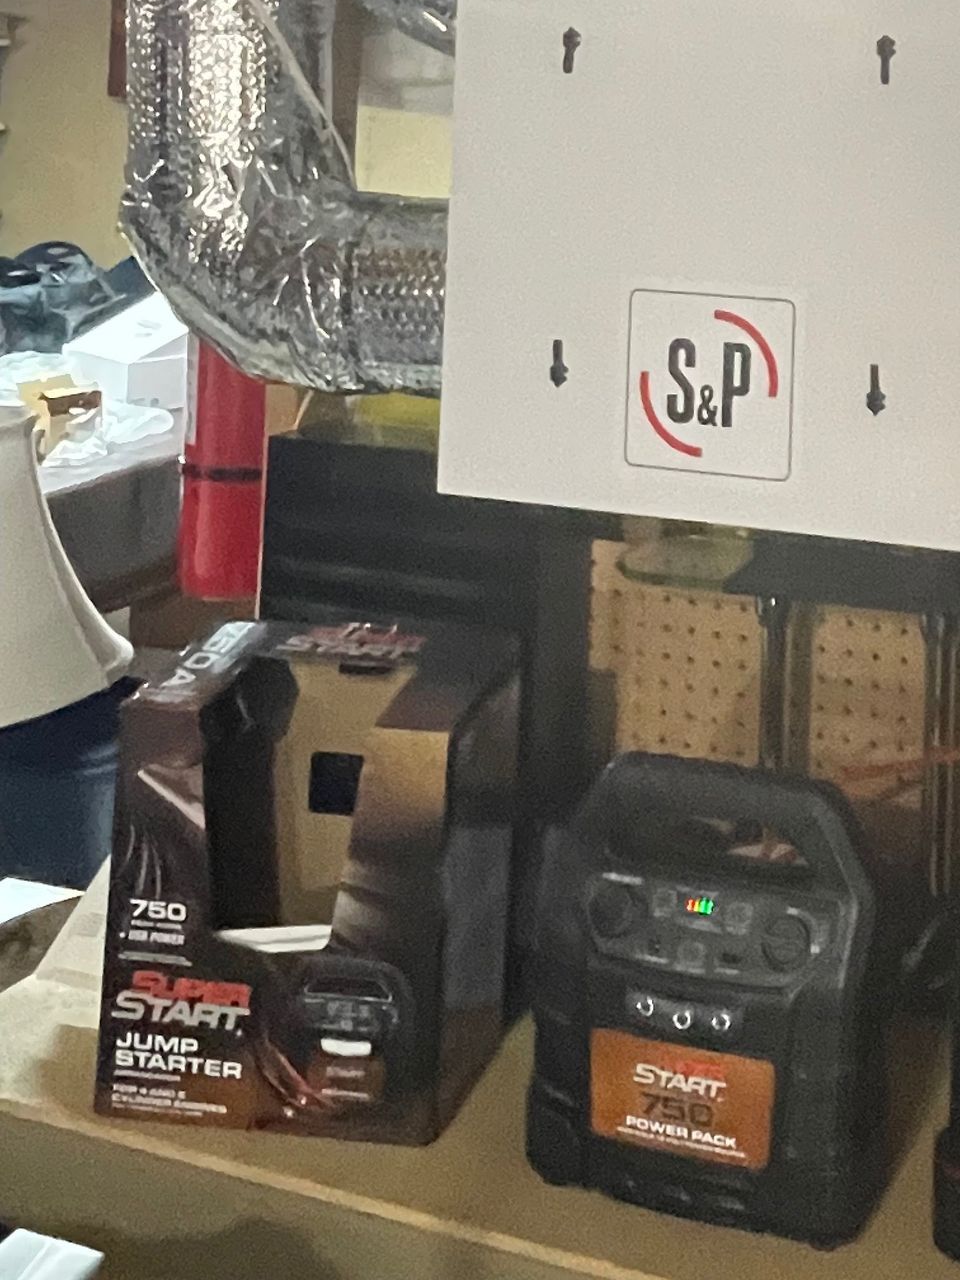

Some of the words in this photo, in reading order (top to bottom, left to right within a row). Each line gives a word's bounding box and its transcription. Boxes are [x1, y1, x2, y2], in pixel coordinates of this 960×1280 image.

[666, 337, 752, 427] S&P
[129, 898, 187, 921] 750
[111, 989, 250, 1030] START
[115, 1032, 199, 1054] JUMP
[115, 1049, 242, 1079] STARTER
[633, 1063, 727, 1098] START
[641, 1090, 715, 1126] 750
[626, 1115, 689, 1140] POWER
[691, 1130, 737, 1148] PACK
